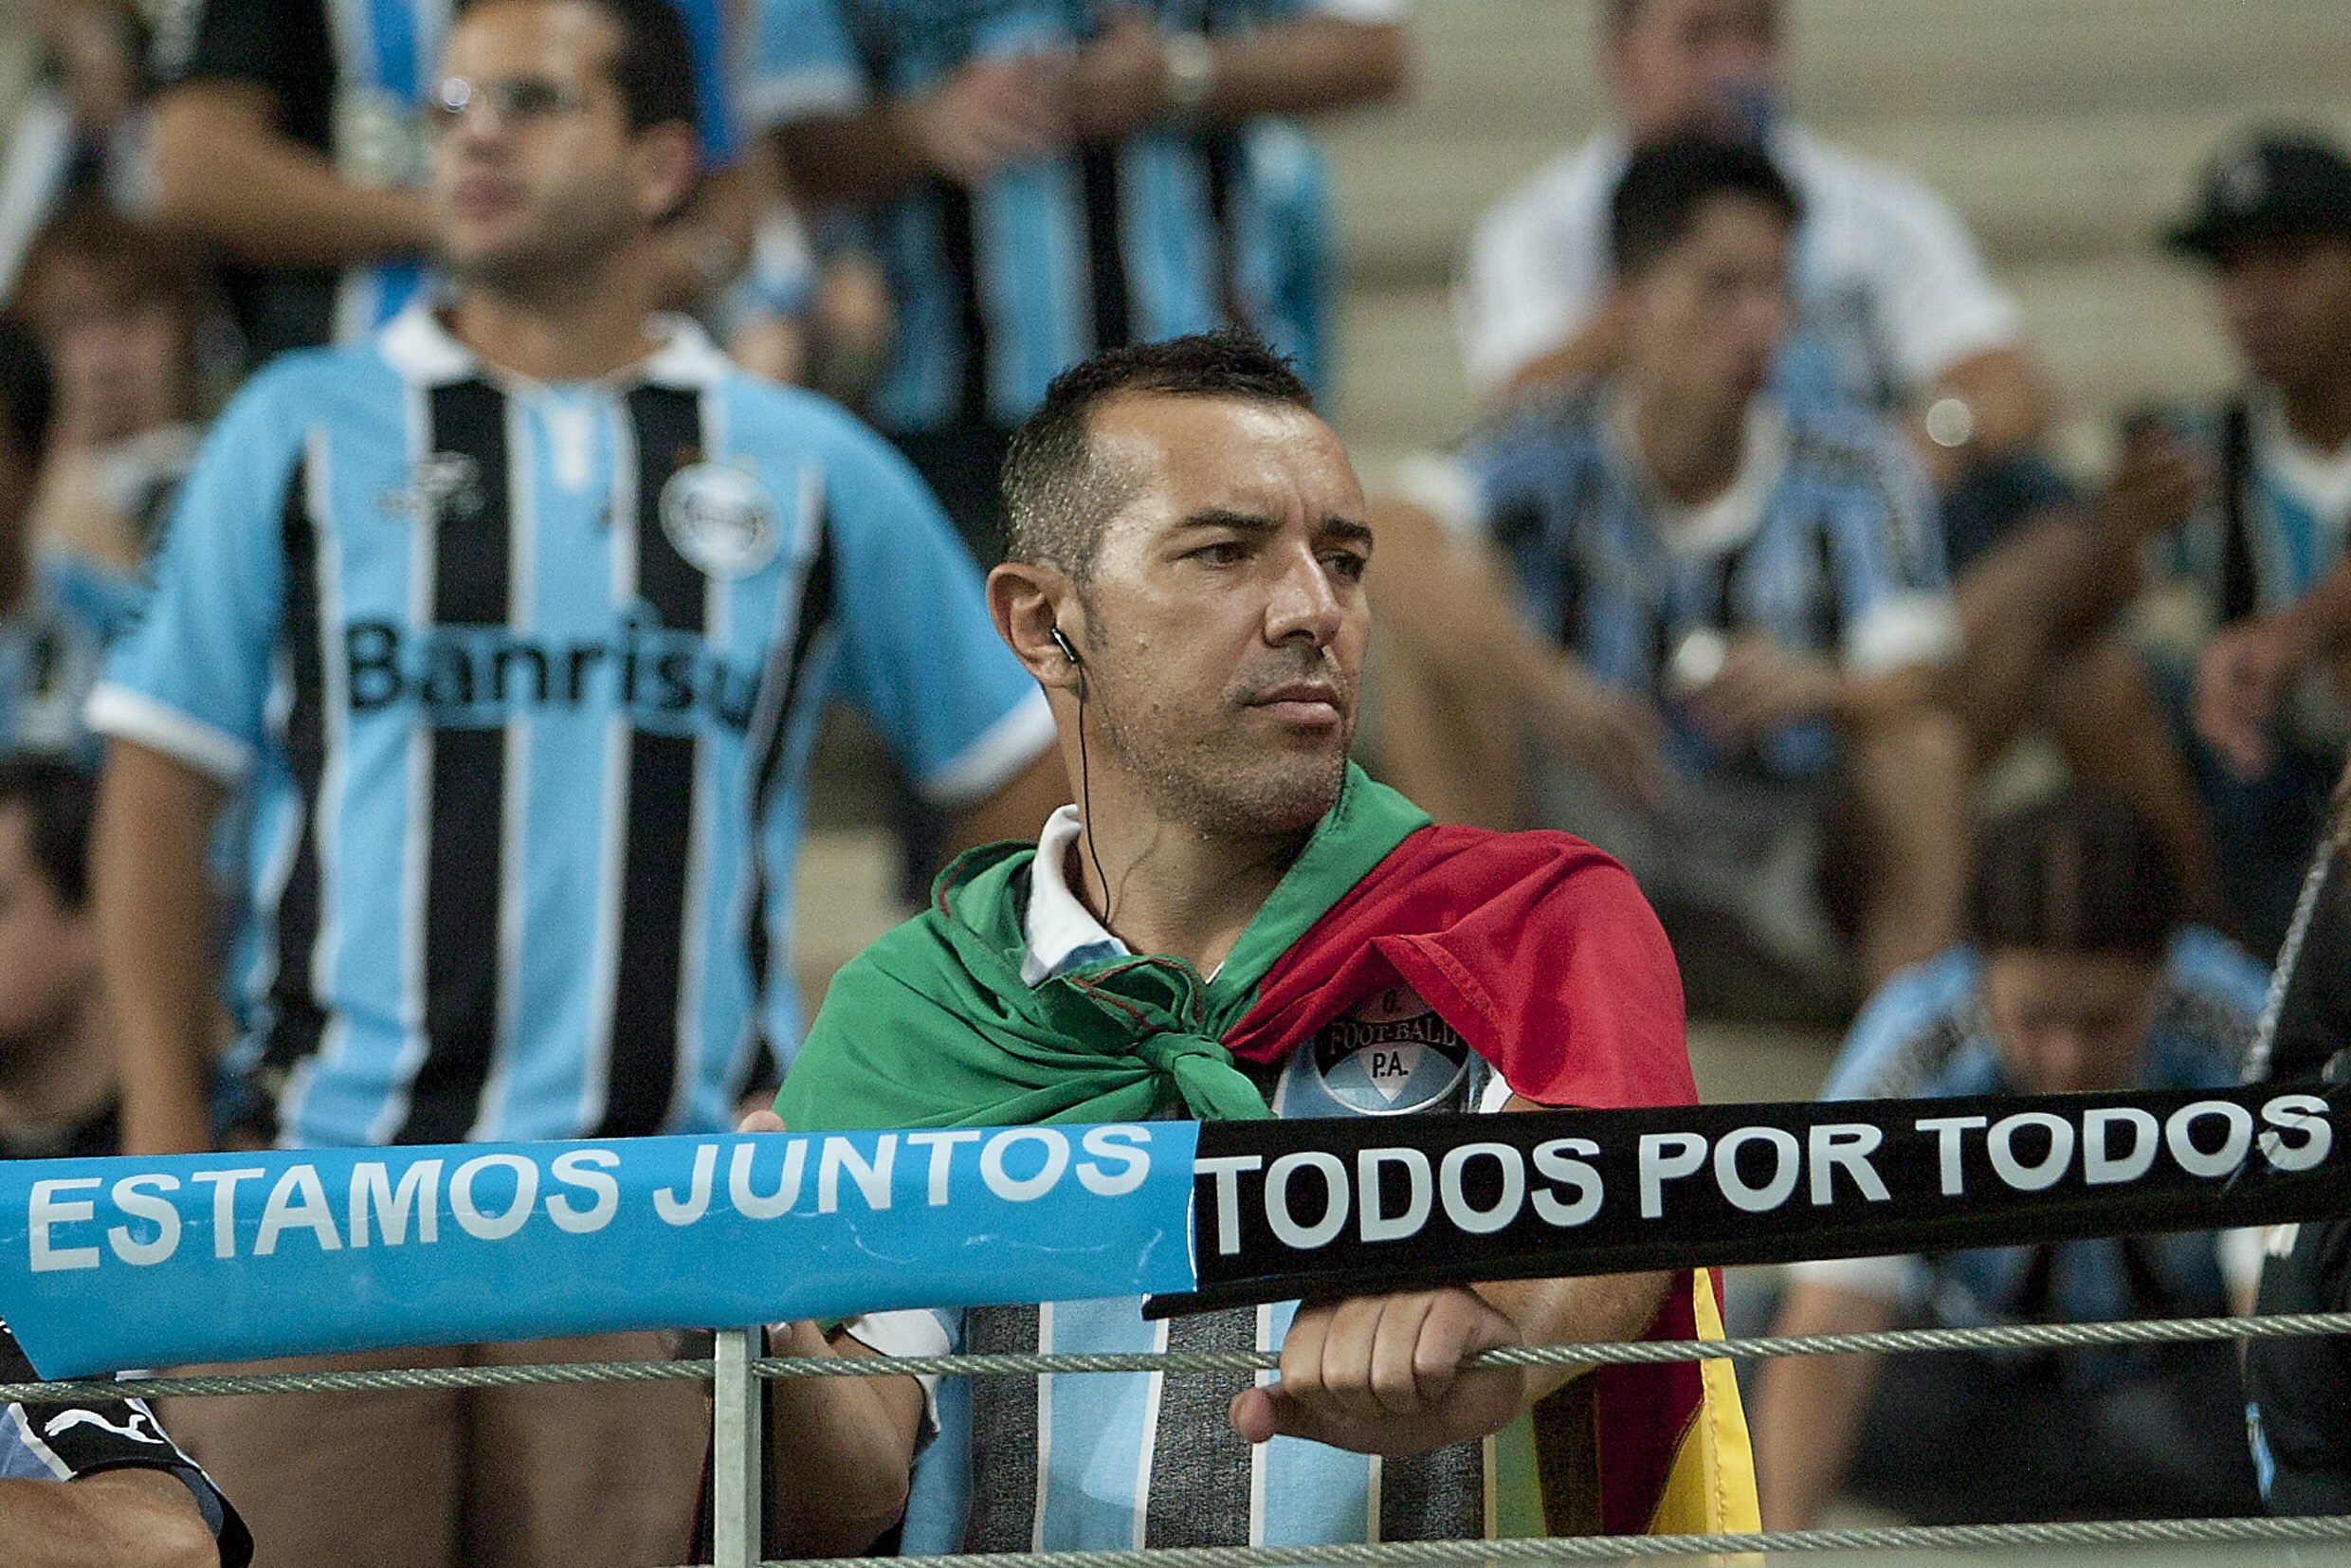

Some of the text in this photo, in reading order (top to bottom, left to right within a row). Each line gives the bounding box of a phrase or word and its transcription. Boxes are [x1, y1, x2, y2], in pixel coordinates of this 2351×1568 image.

[346, 613, 764, 730] Banrisu
[1329, 1017, 1458, 1056] FOOT-BALL
[1371, 1050, 1411, 1079] P.A.
[28, 1123, 1152, 1271] ESTAMOS JUNTOS
[1195, 1094, 2331, 1255] TODOS POR TODOS
